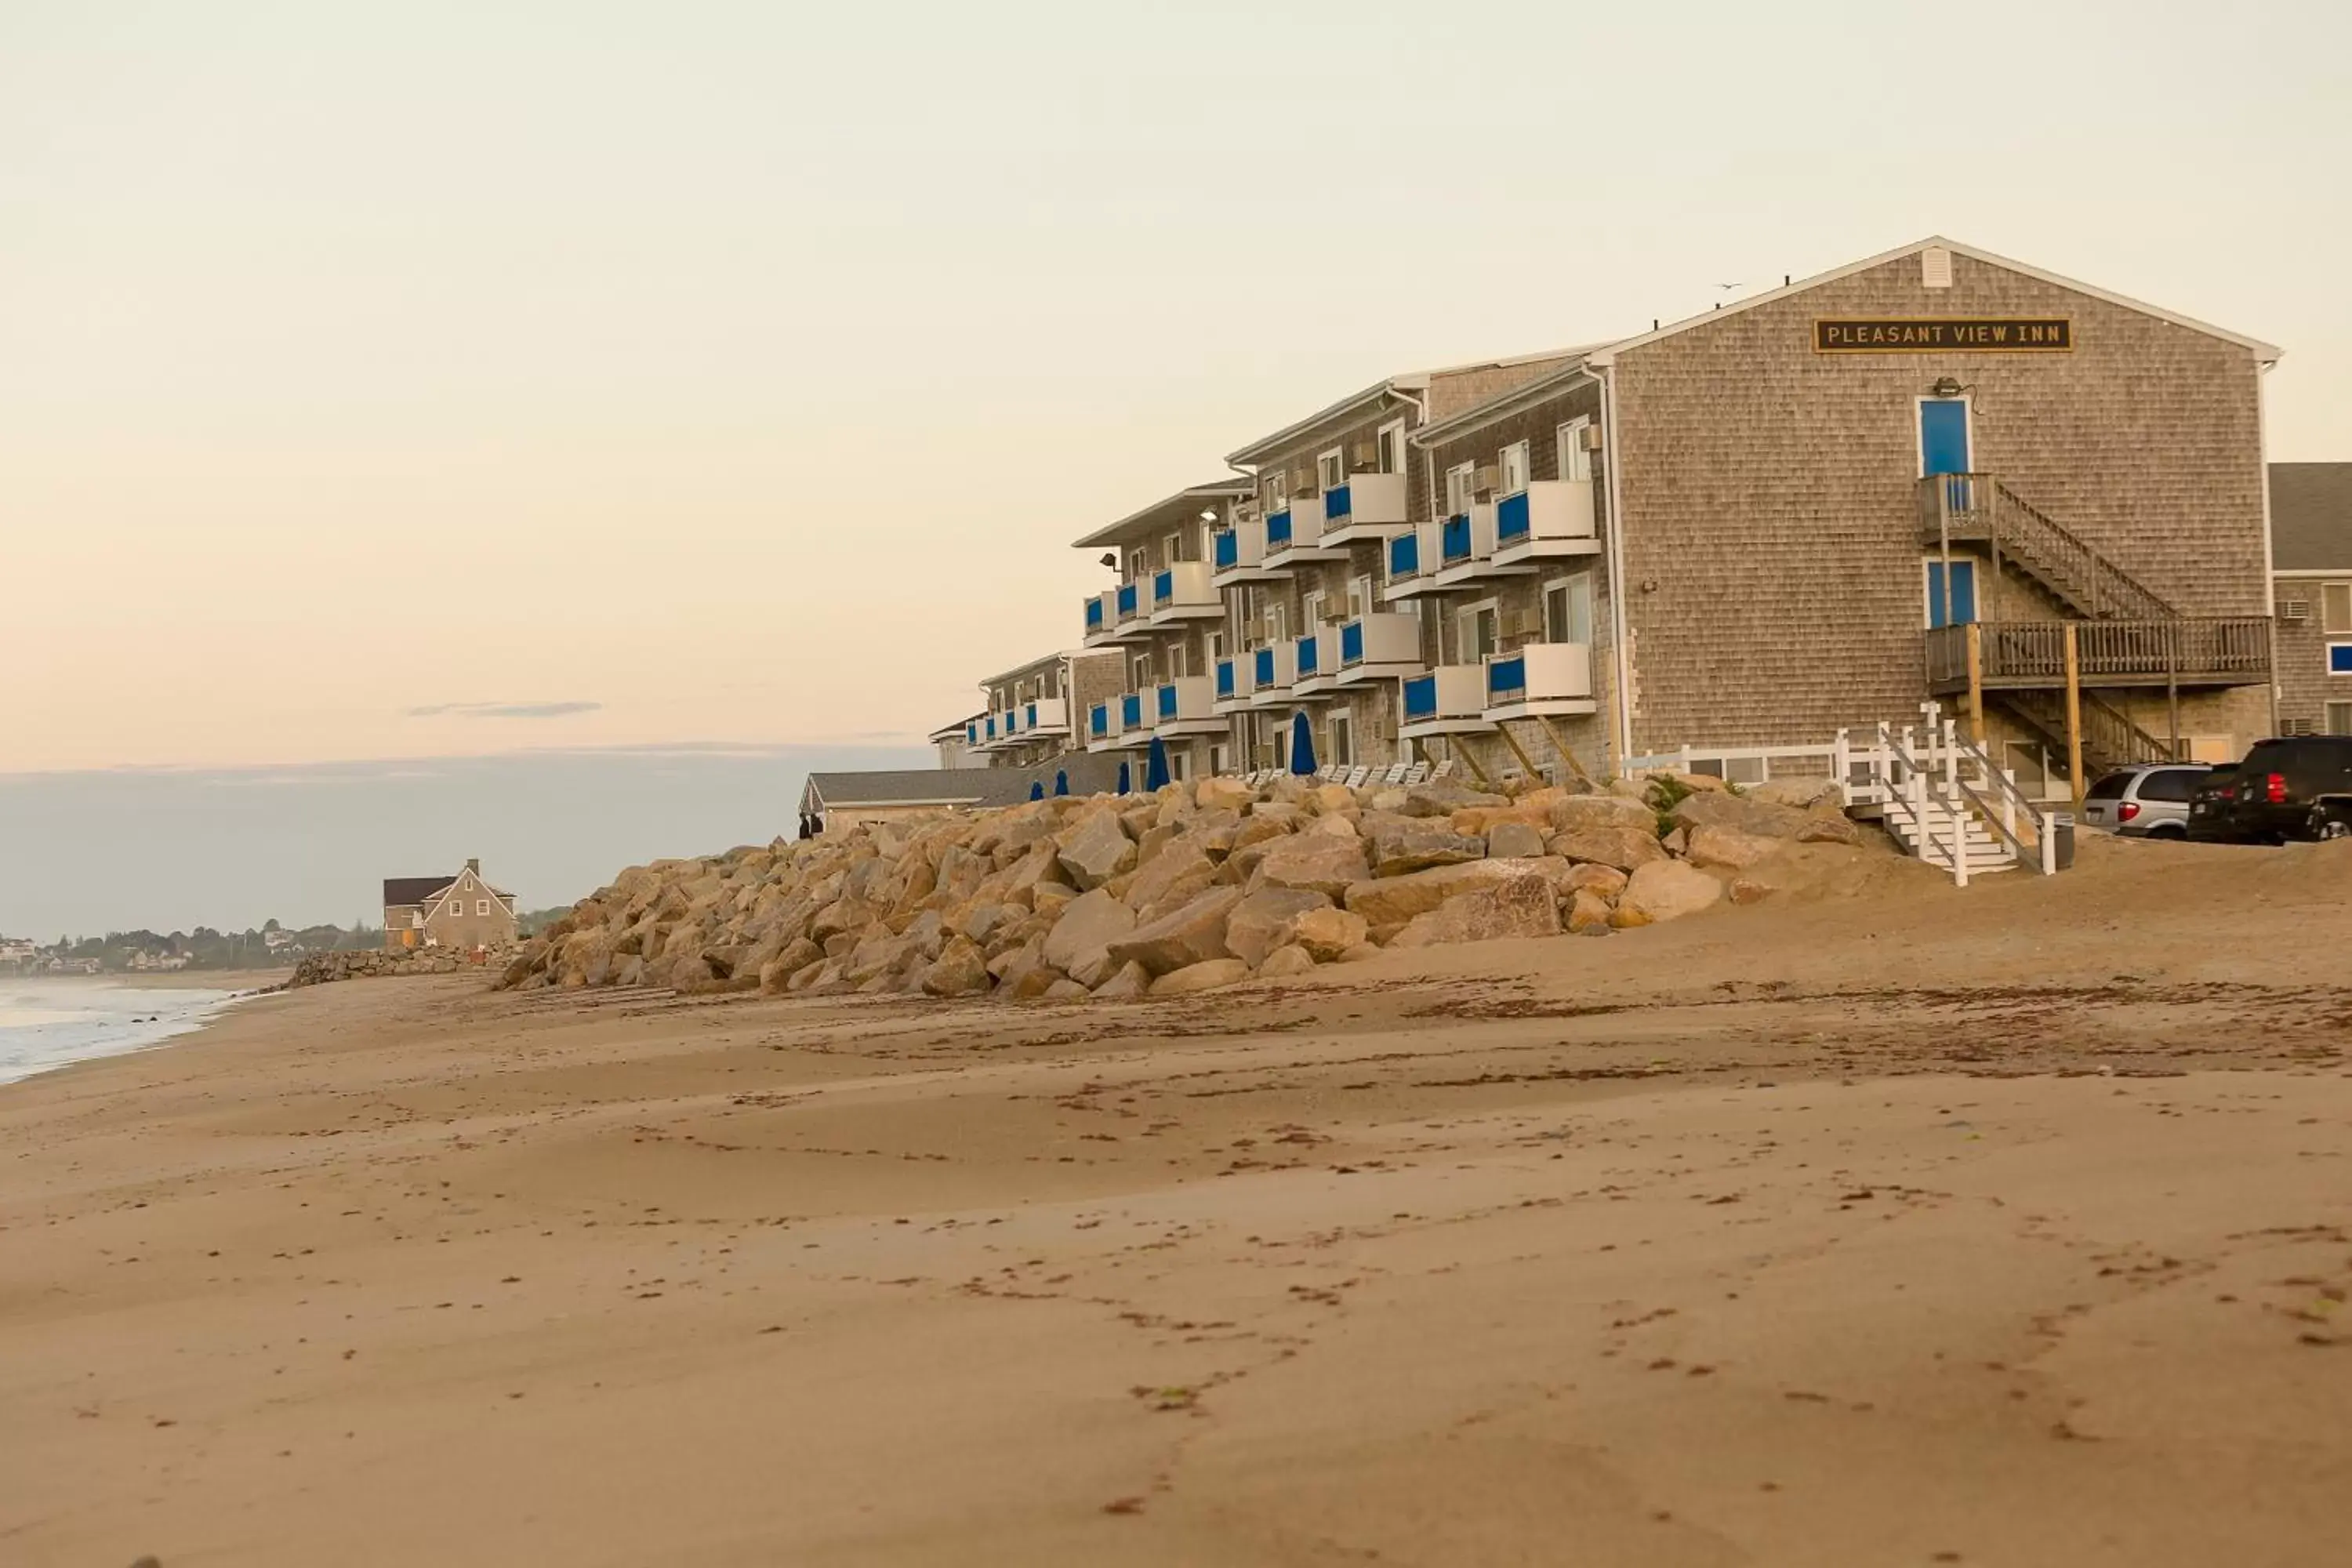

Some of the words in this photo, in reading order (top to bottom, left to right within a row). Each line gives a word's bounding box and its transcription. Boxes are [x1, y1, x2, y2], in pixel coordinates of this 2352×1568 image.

[1828, 326, 1944, 343] PLEASANT
[1953, 326, 2007, 343] VIEW
[2019, 325, 2060, 342] INN
